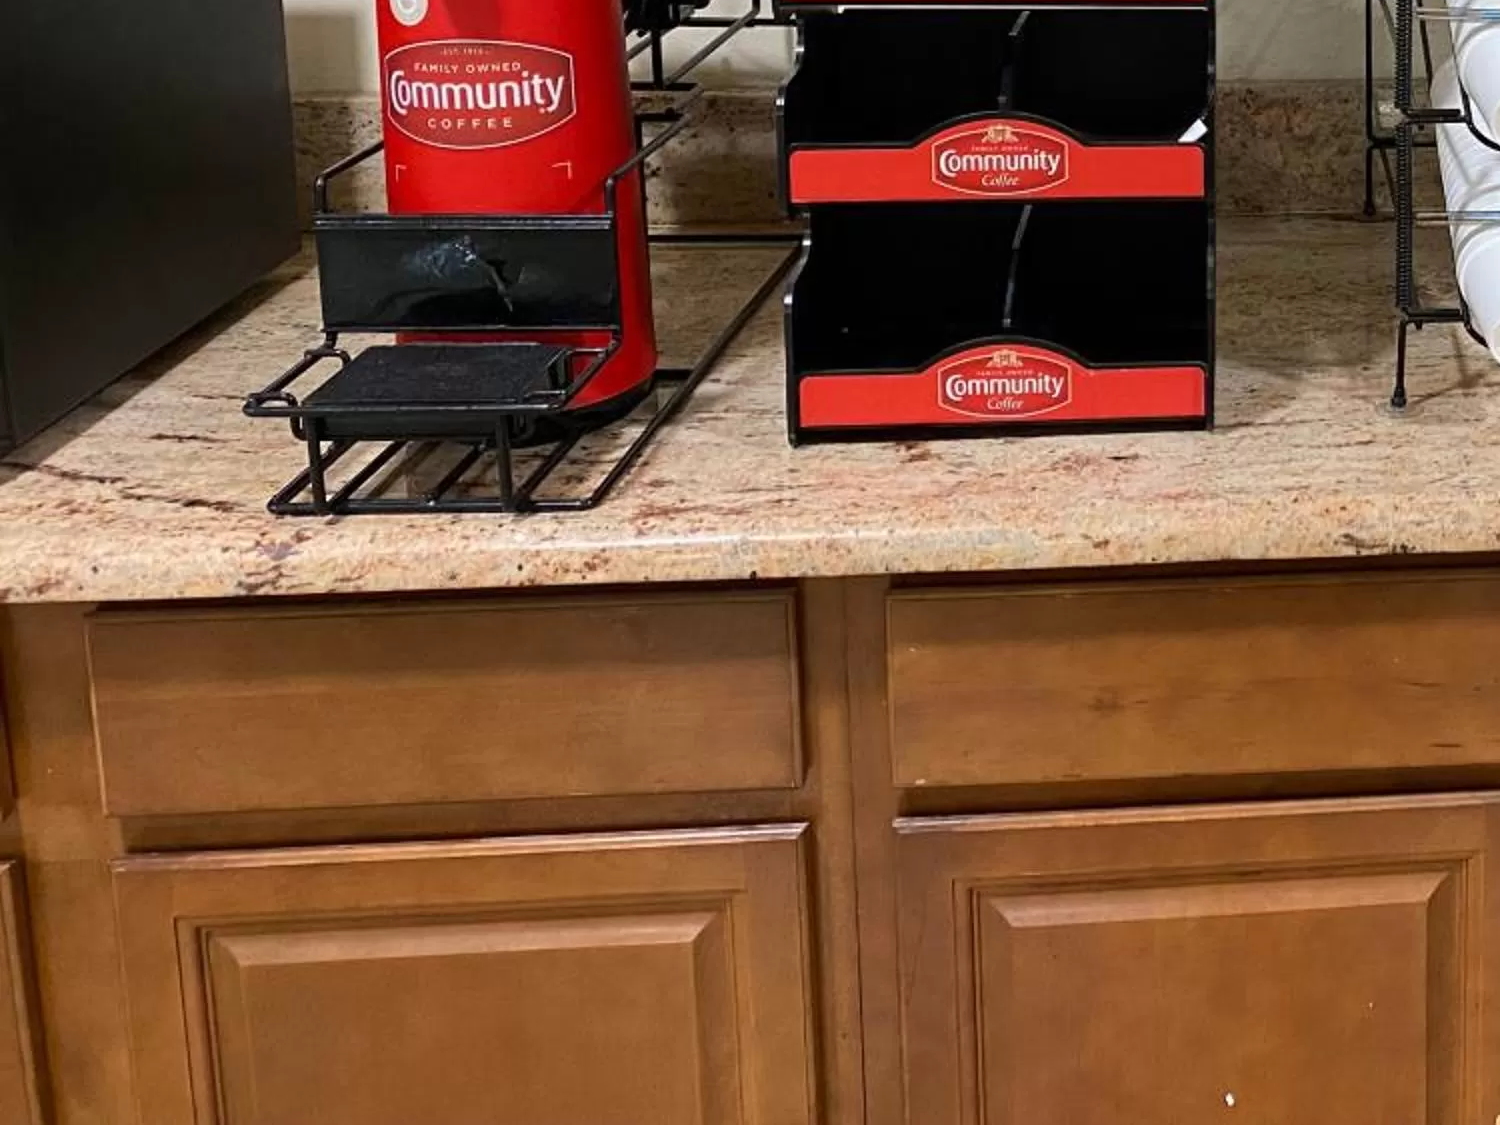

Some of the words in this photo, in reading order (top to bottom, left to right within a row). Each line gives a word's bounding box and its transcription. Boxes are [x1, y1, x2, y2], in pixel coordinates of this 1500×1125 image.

[413, 62, 459, 74] FAMILY
[465, 62, 521, 74] OWNED
[390, 70, 565, 116] Community
[427, 117, 513, 130] COFFEE
[939, 148, 1060, 178] Community
[981, 174, 1020, 187] Coffee
[945, 373, 1064, 402] Community
[986, 397, 1024, 411] Coffee
